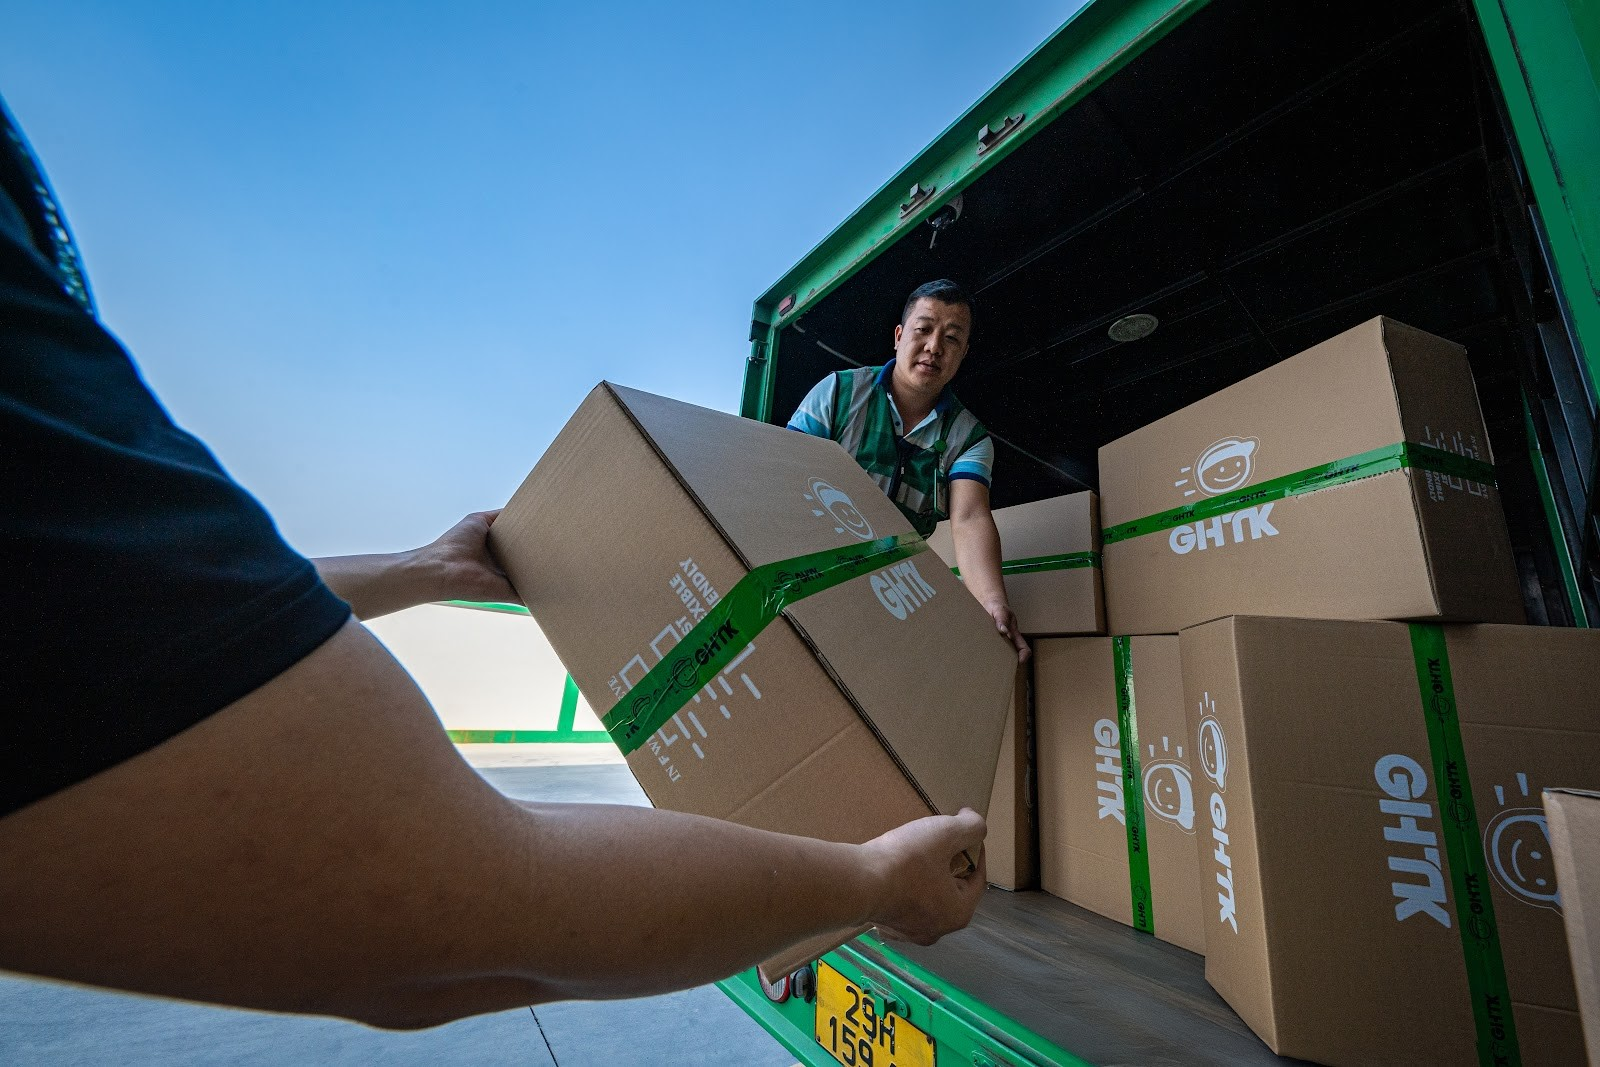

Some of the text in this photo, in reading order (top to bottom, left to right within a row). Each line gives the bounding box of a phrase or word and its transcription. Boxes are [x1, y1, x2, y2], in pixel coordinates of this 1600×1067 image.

[1169, 502, 1280, 556] GHTK
[1172, 509, 1196, 522] GHTK
[870, 560, 937, 621] GHTK
[674, 616, 694, 636] ST
[694, 617, 740, 666] GHTK
[1427, 657, 1444, 694] GHTK
[658, 755, 671, 766] F
[665, 764, 682, 782] IN
[1093, 718, 1126, 827] GHTK
[1445, 759, 1464, 801] GHTK
[1132, 826, 1141, 854] GHTK
[1375, 754, 1452, 929] GHTK
[1209, 793, 1238, 935] GHTK
[1464, 871, 1485, 915] GHTK
[845, 985, 895, 1056] 29H
[1485, 993, 1506, 1041] GHTK
